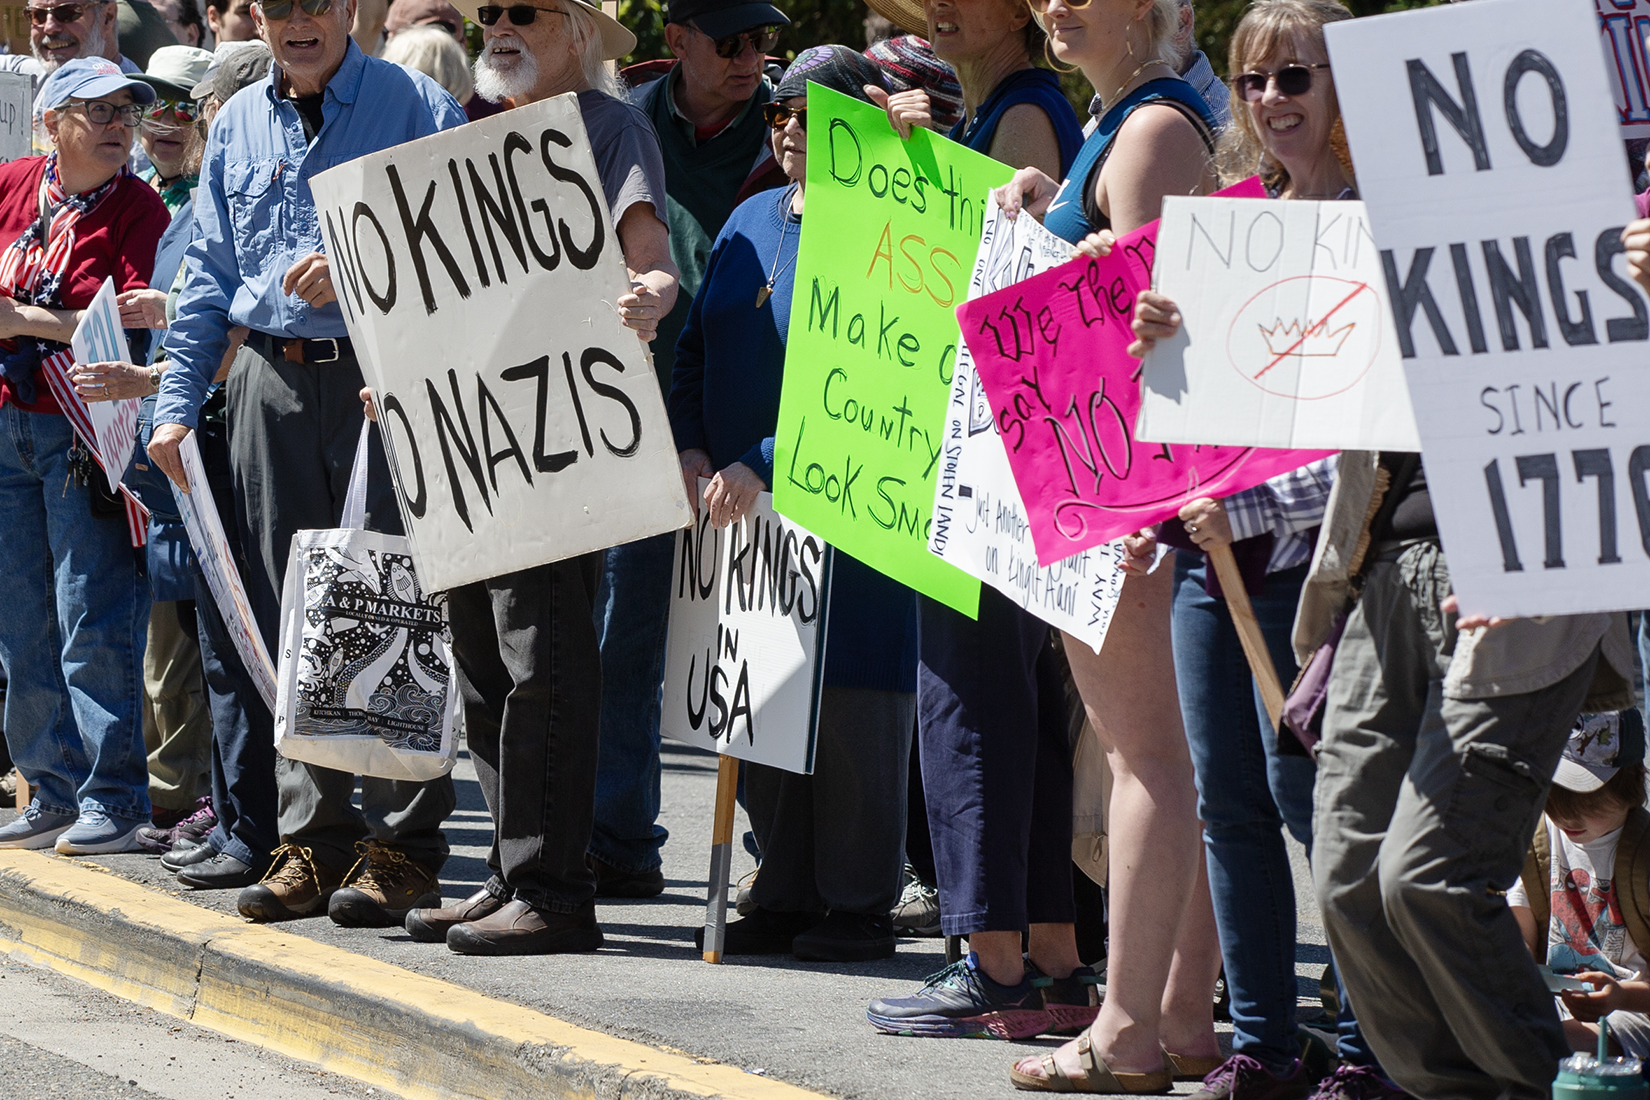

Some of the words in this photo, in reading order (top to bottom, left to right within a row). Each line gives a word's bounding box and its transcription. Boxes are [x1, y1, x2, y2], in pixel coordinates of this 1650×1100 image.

[1405, 48, 1568, 176] NO
[829, 117, 929, 214] Does
[942, 164, 986, 242] thi
[326, 201, 397, 324] NO
[385, 128, 605, 317] KINGS
[866, 216, 962, 308] ASS
[984, 220, 994, 245] NO
[1186, 210, 1284, 272] NO
[1312, 213, 1375, 271] KIN
[808, 275, 921, 367] Make
[979, 296, 1061, 363] We
[1379, 227, 1650, 359] KINGS
[426, 347, 641, 534] NAZIS
[824, 368, 942, 481] Country
[951, 419, 962, 440] ON
[1044, 377, 1132, 498] NO
[1480, 377, 1617, 436] SINCE
[787, 416, 864, 522] Look
[679, 509, 717, 602] NO
[726, 515, 824, 628] KINGS
[986, 545, 998, 575] on
[326, 595, 337, 608] A
[339, 596, 351, 610] &
[354, 598, 364, 611] P
[365, 600, 442, 624] MARKETS
[718, 623, 739, 663] IN
[367, 715, 379, 723] BAY
[387, 719, 426, 731] LIGHTHOUSE
[687, 647, 754, 746] USA
